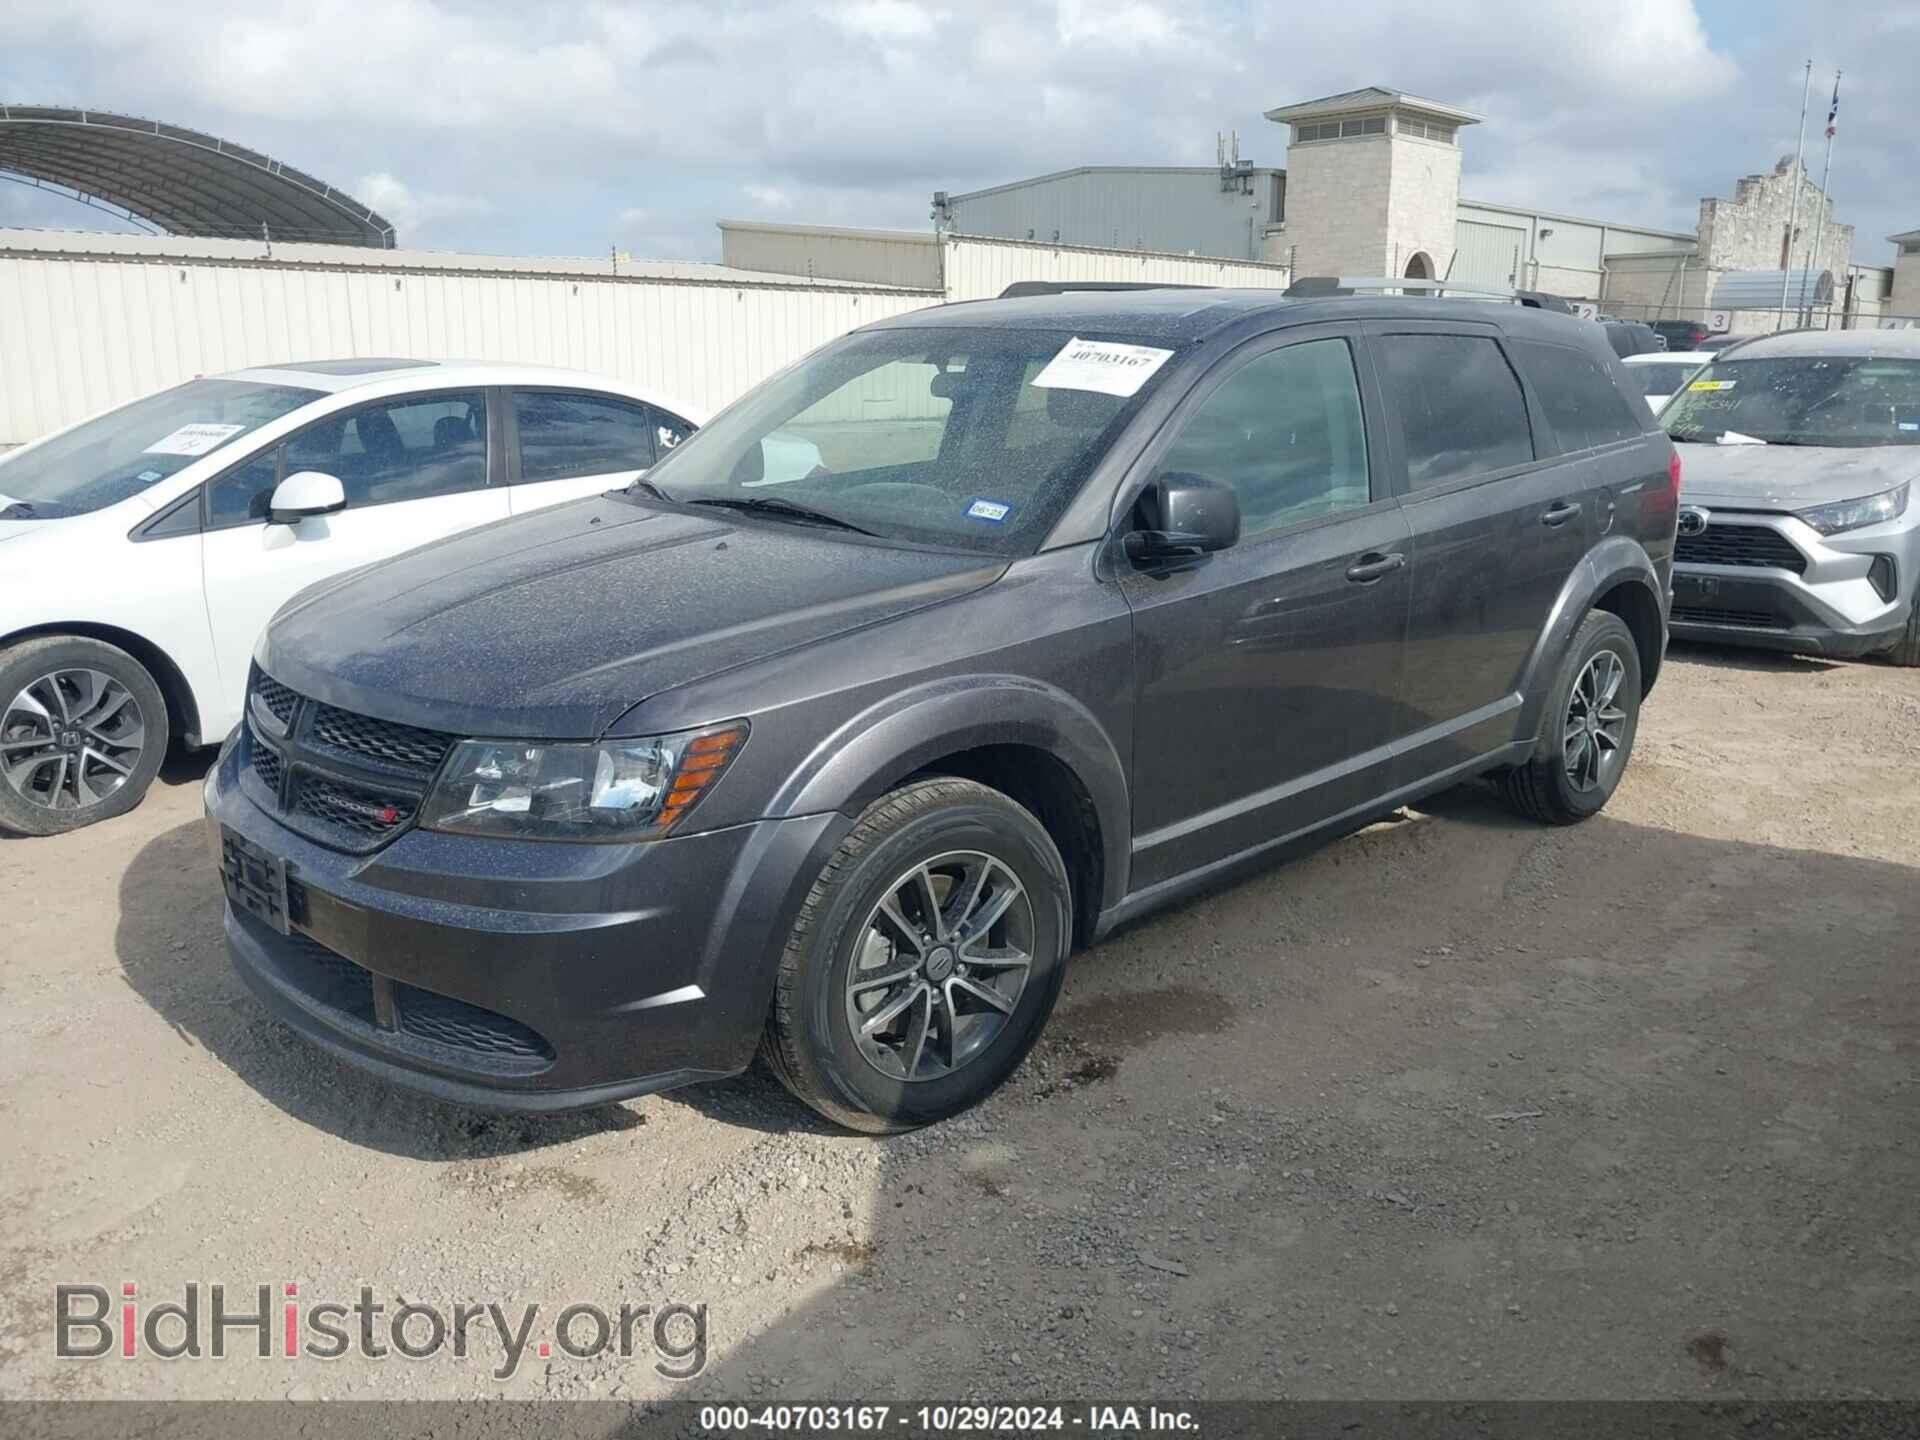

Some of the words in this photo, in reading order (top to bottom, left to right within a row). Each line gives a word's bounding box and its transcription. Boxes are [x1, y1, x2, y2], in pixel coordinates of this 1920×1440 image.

[1583, 308, 1593, 320] 2
[1714, 314, 1725, 328] 3
[1070, 352, 1153, 367] 40703167
